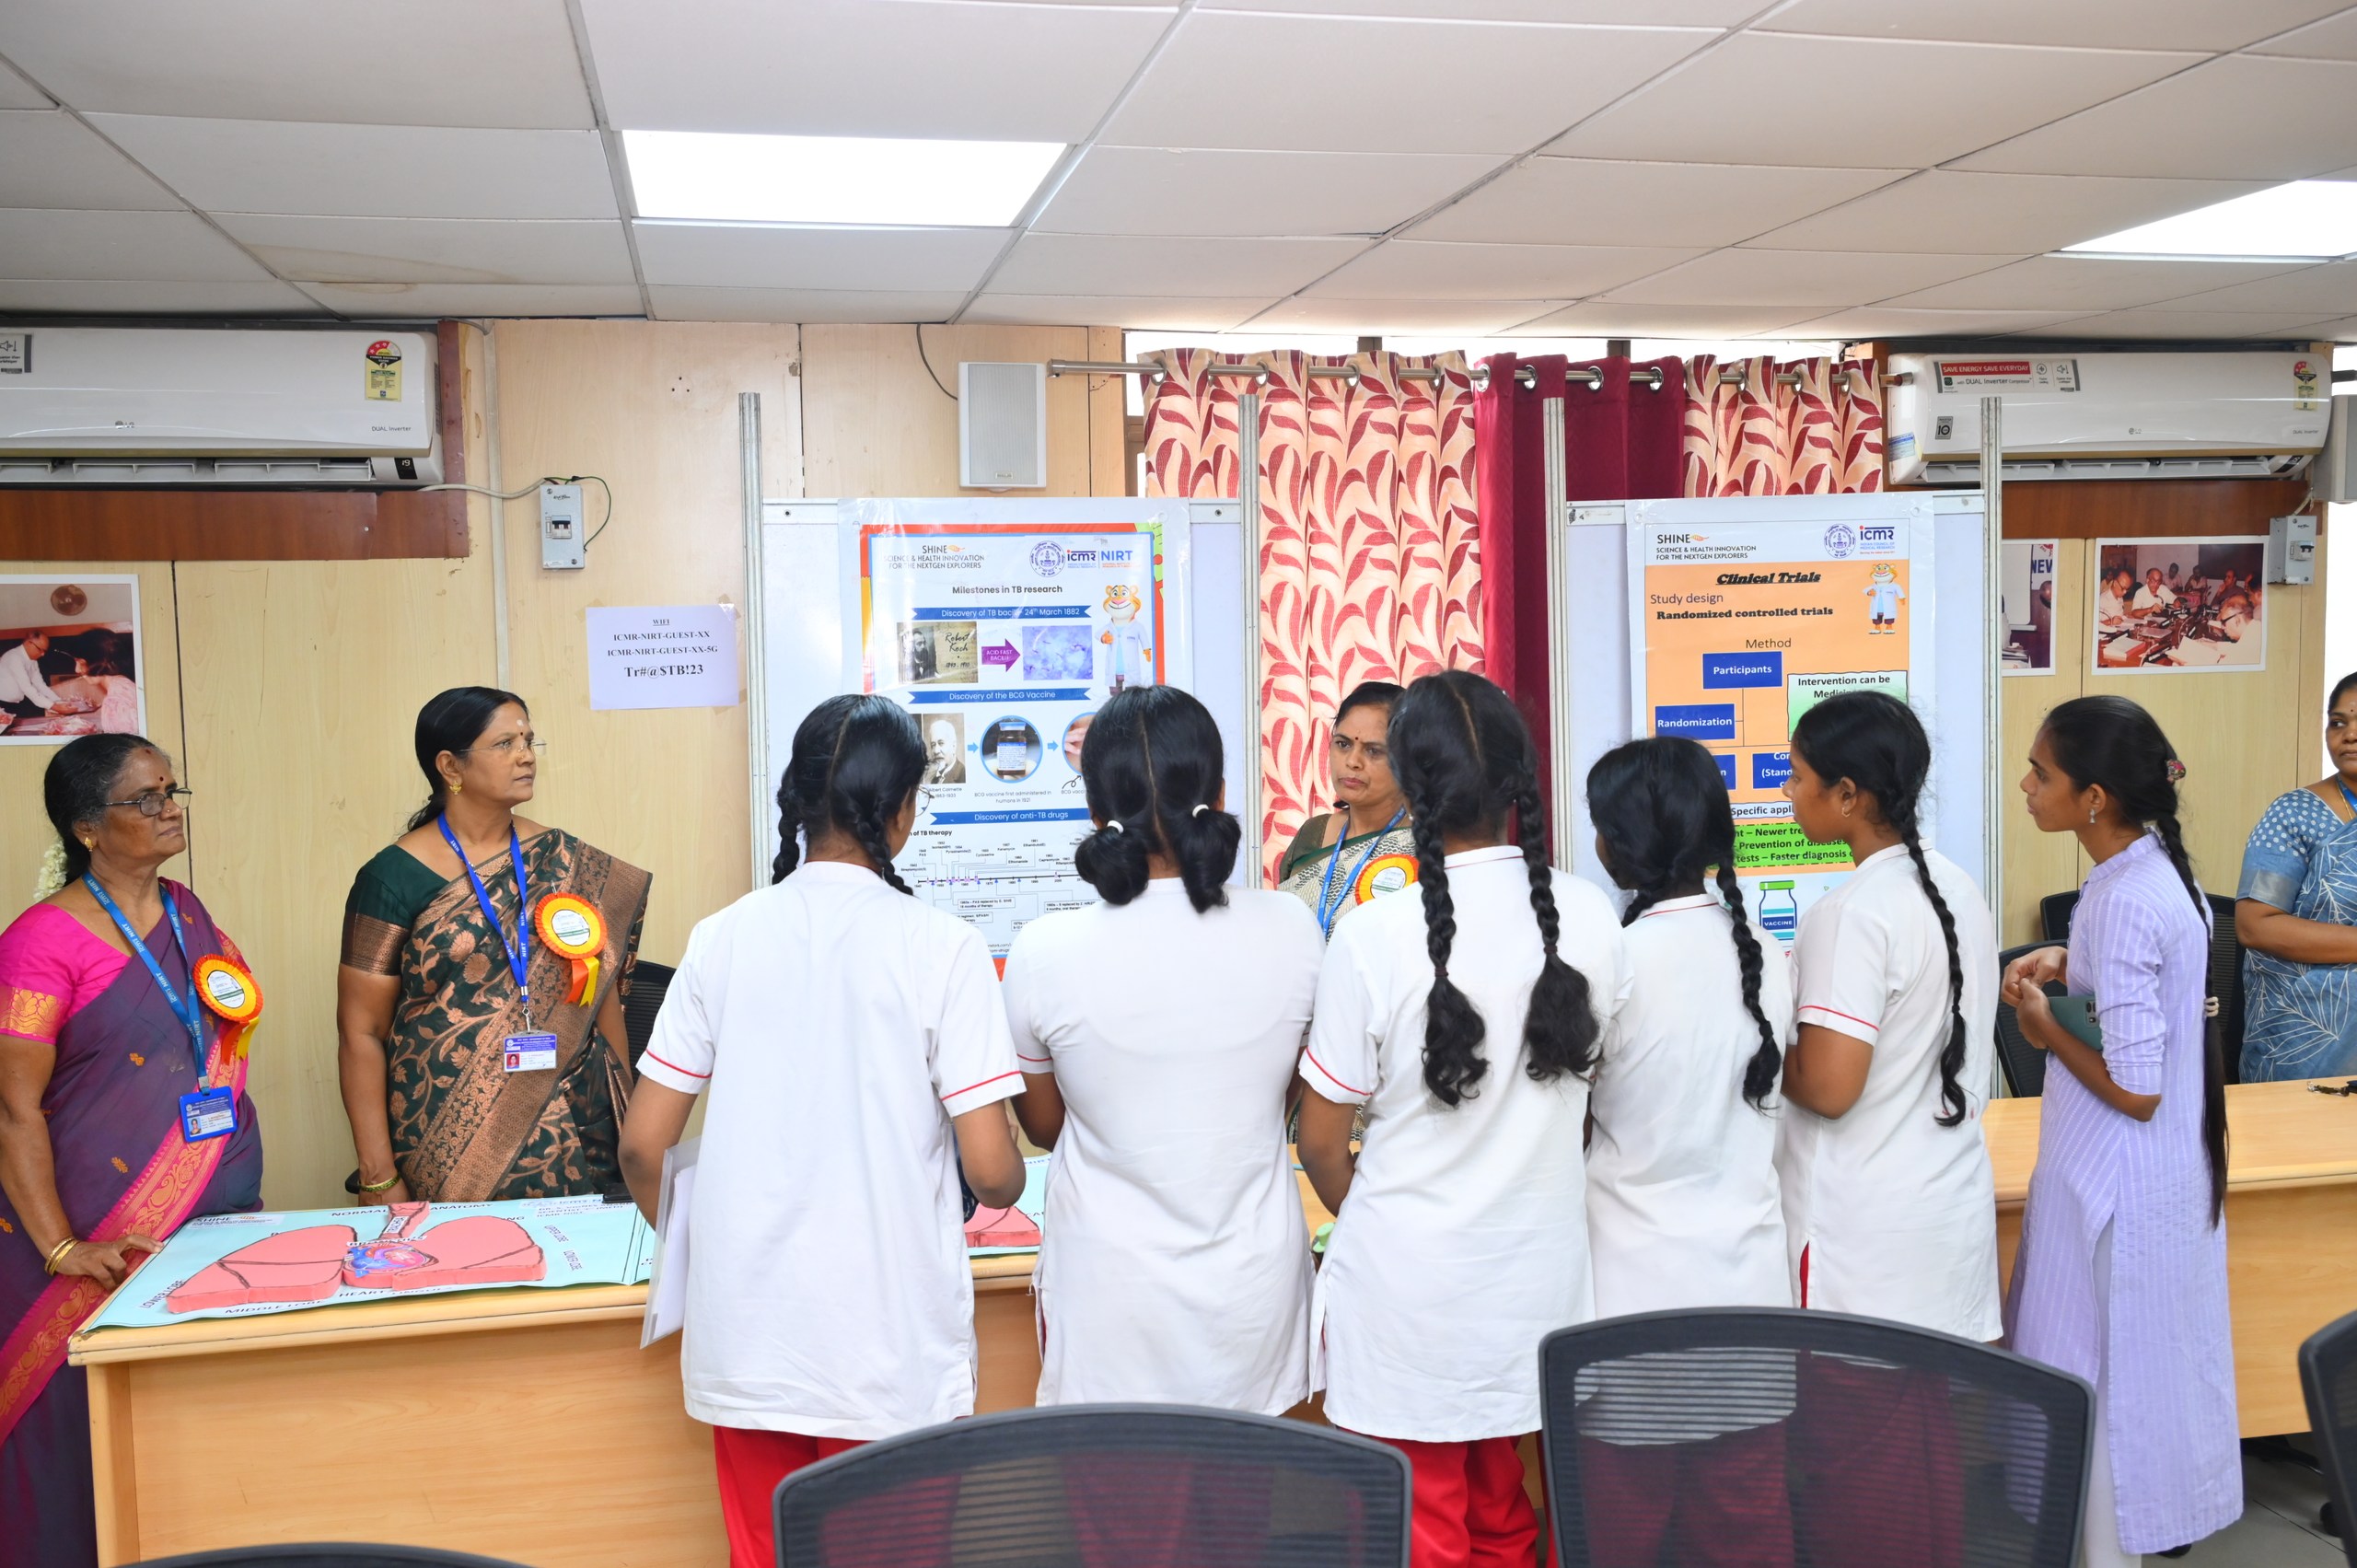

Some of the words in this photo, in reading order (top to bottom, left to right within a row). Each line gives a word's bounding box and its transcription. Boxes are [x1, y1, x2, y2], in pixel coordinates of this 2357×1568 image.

[1657, 534, 1690, 544] SHINE
[922, 545, 947, 553] SHINE
[1101, 551, 1132, 561] NIRT
[1716, 573, 1775, 585] Clinical
[1778, 572, 1821, 584] Trials
[952, 586, 1000, 594] Milestones
[1650, 594, 1683, 605] Study
[1686, 592, 1724, 605] design
[941, 610, 976, 618] Discovery
[1656, 610, 1732, 620] Randomized
[1735, 608, 1797, 618] controlled
[1801, 607, 1833, 616] trials
[613, 631, 710, 641] ICMR-NIRT-GUEST-XX
[945, 633, 970, 643] Robert
[949, 643, 969, 652] Koch
[1746, 638, 1792, 648] Method
[608, 645, 718, 656] ICMR-NIRT-GUEST-XX-5G
[624, 664, 703, 679] Tr#@STB!23
[1713, 666, 1772, 677] Participants
[1798, 676, 1857, 686] Intervention
[1878, 675, 1890, 683] be
[950, 692, 984, 701] Discovery
[1657, 716, 1733, 728] Randomization
[974, 814, 1009, 822] Discovery
[1048, 811, 1068, 819] drugs
[1731, 805, 1768, 817] Specific
[1739, 840, 1792, 850] Prevention
[1771, 853, 1799, 861] Faster
[1803, 850, 1846, 860] diagnosis
[122, 923, 135, 937] NIRT
[156, 972, 169, 987] NIRT
[225, 1306, 283, 1314] MIDDLE
